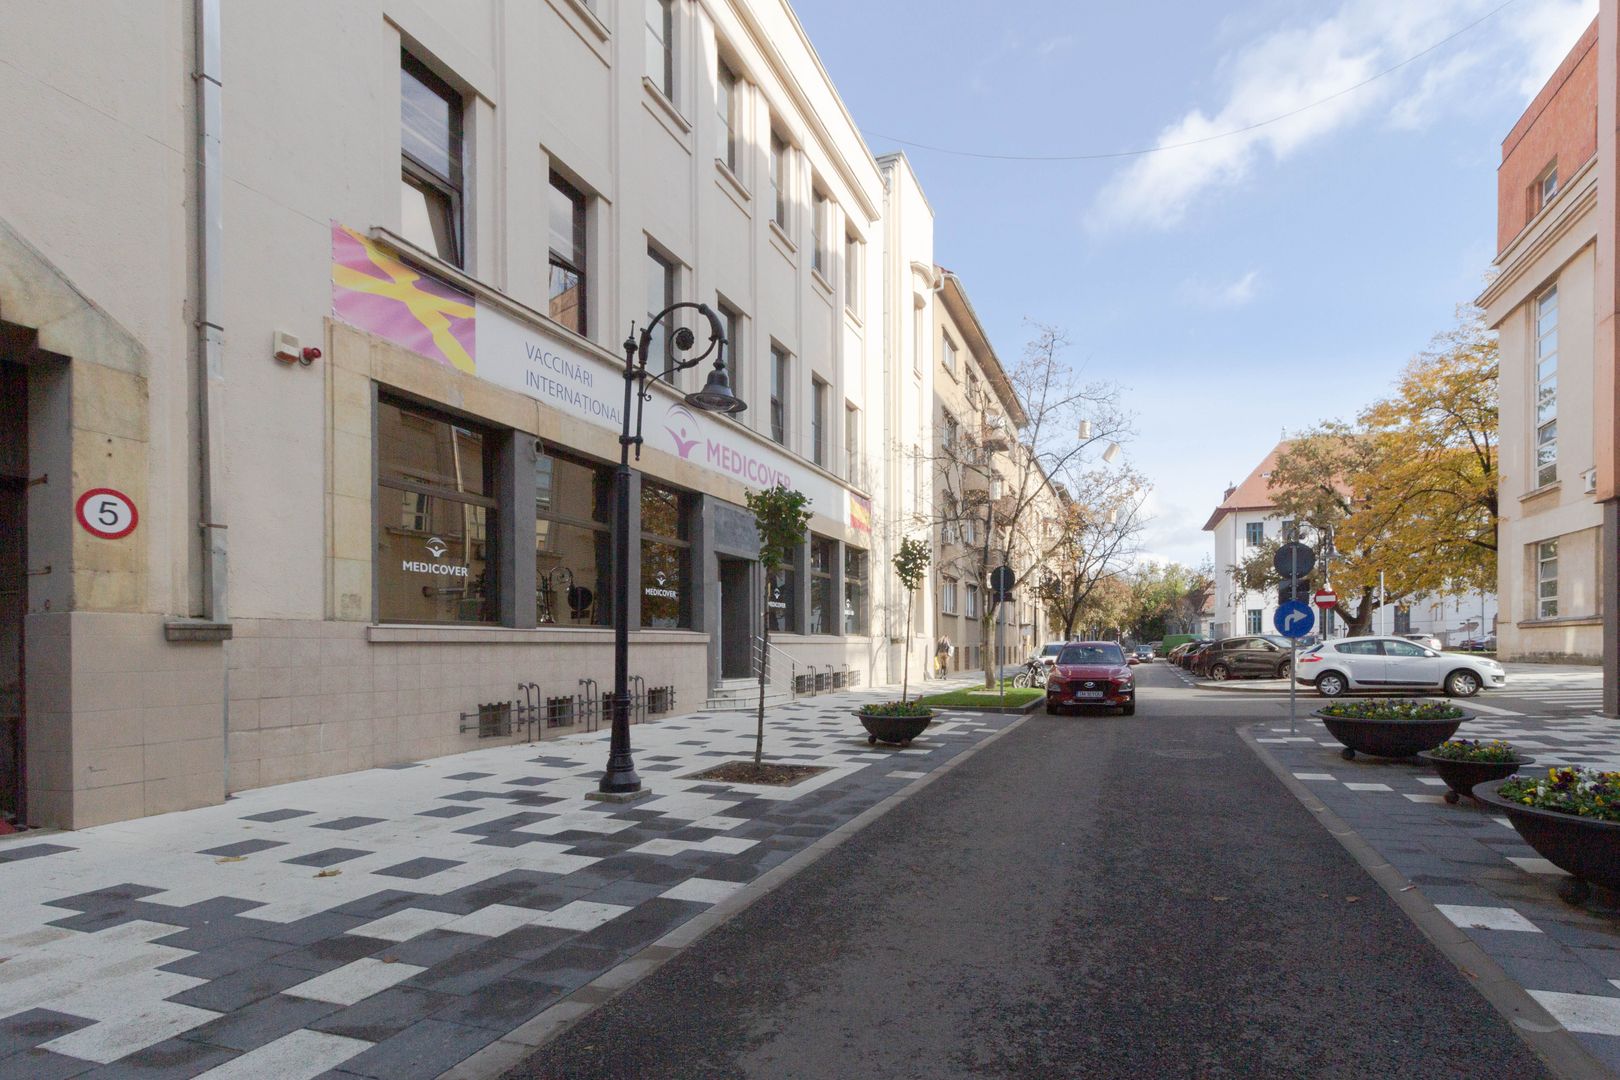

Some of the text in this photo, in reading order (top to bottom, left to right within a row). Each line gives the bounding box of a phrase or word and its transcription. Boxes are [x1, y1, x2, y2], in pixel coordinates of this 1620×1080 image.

[525, 341, 593, 388] VACCINĂRI
[98, 500, 119, 526] 5
[402, 560, 469, 577] MEDICOVER
[645, 588, 678, 598] MEDICOVER
